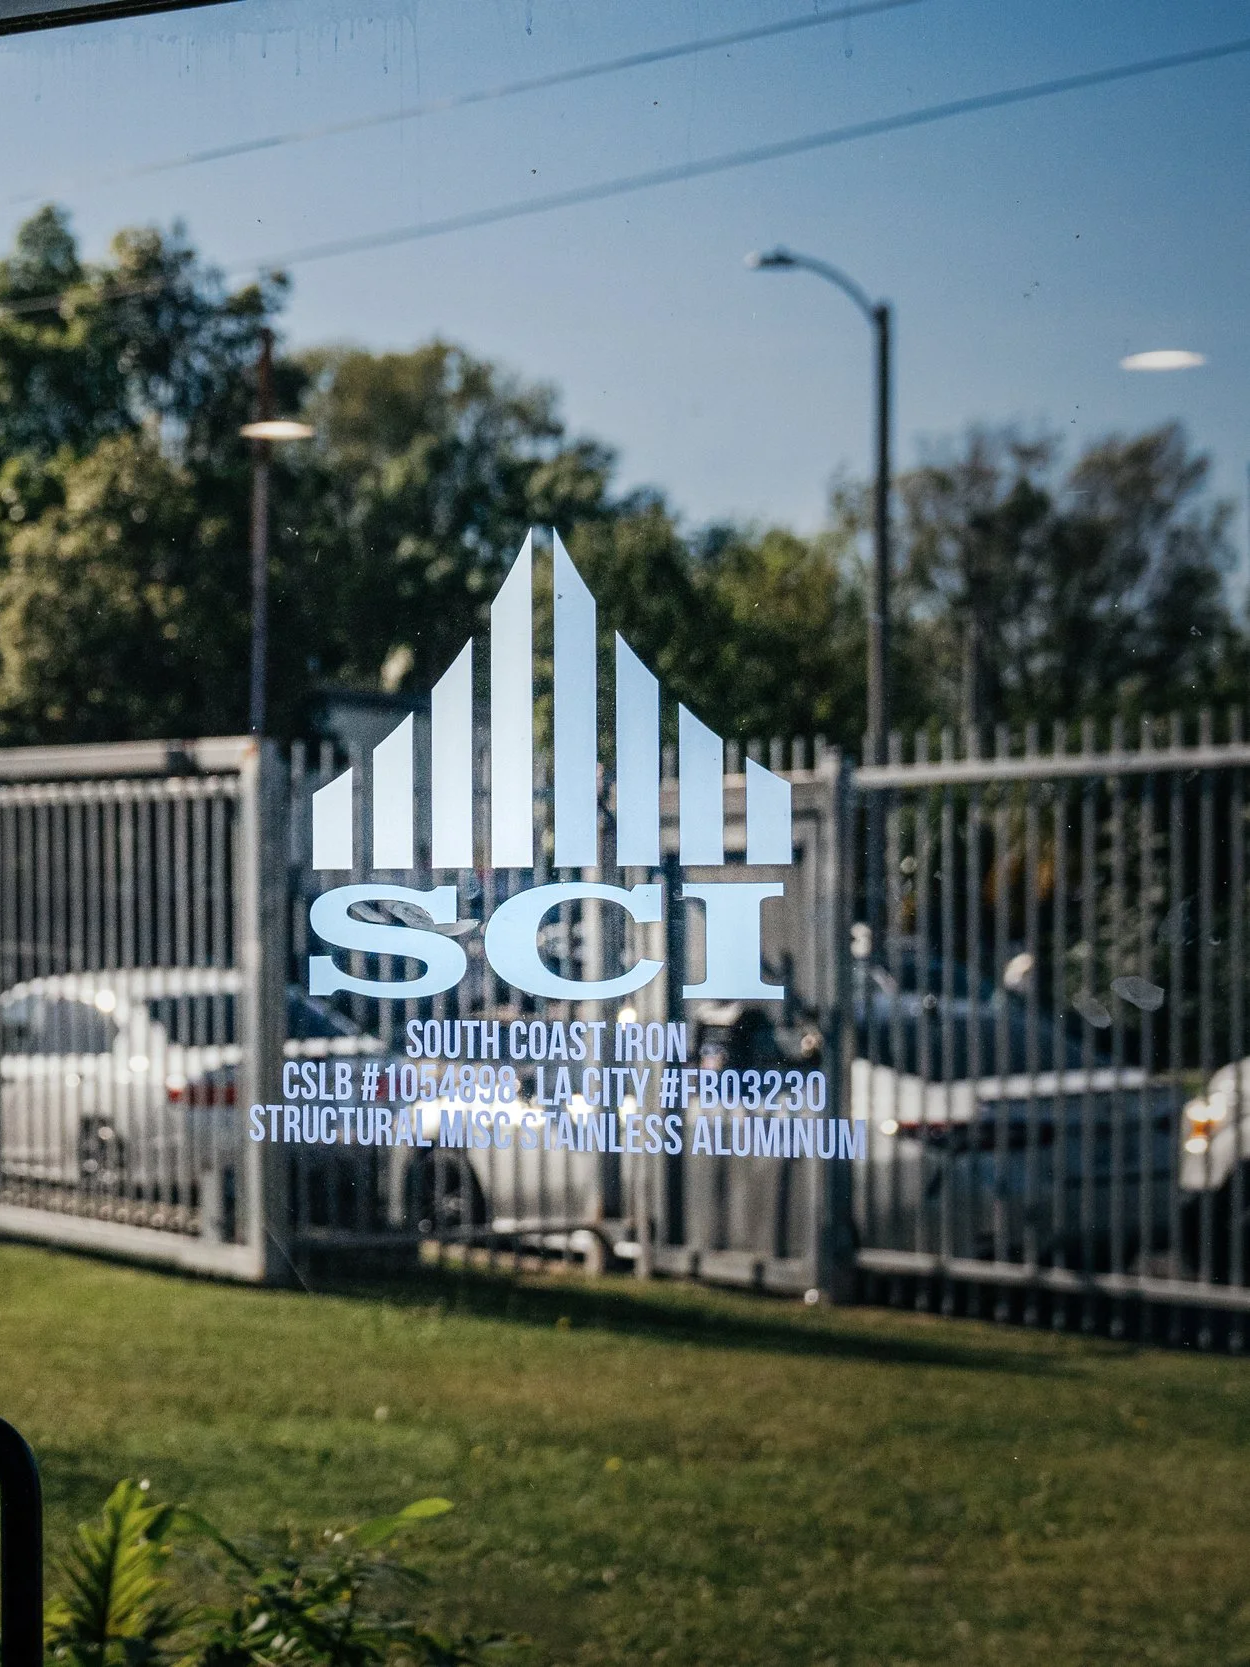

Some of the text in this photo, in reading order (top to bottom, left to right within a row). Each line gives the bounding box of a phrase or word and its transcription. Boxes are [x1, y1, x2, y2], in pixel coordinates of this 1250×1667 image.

[309, 881, 784, 1000] SCI
[406, 1019, 687, 1063] SOUTH COAST IRON
[282, 1061, 826, 1112] CSLB #1054898 LA CITY #FB03230
[250, 1104, 866, 1161] STRUCTURAL MISC STAINLESS ALUMINUM
